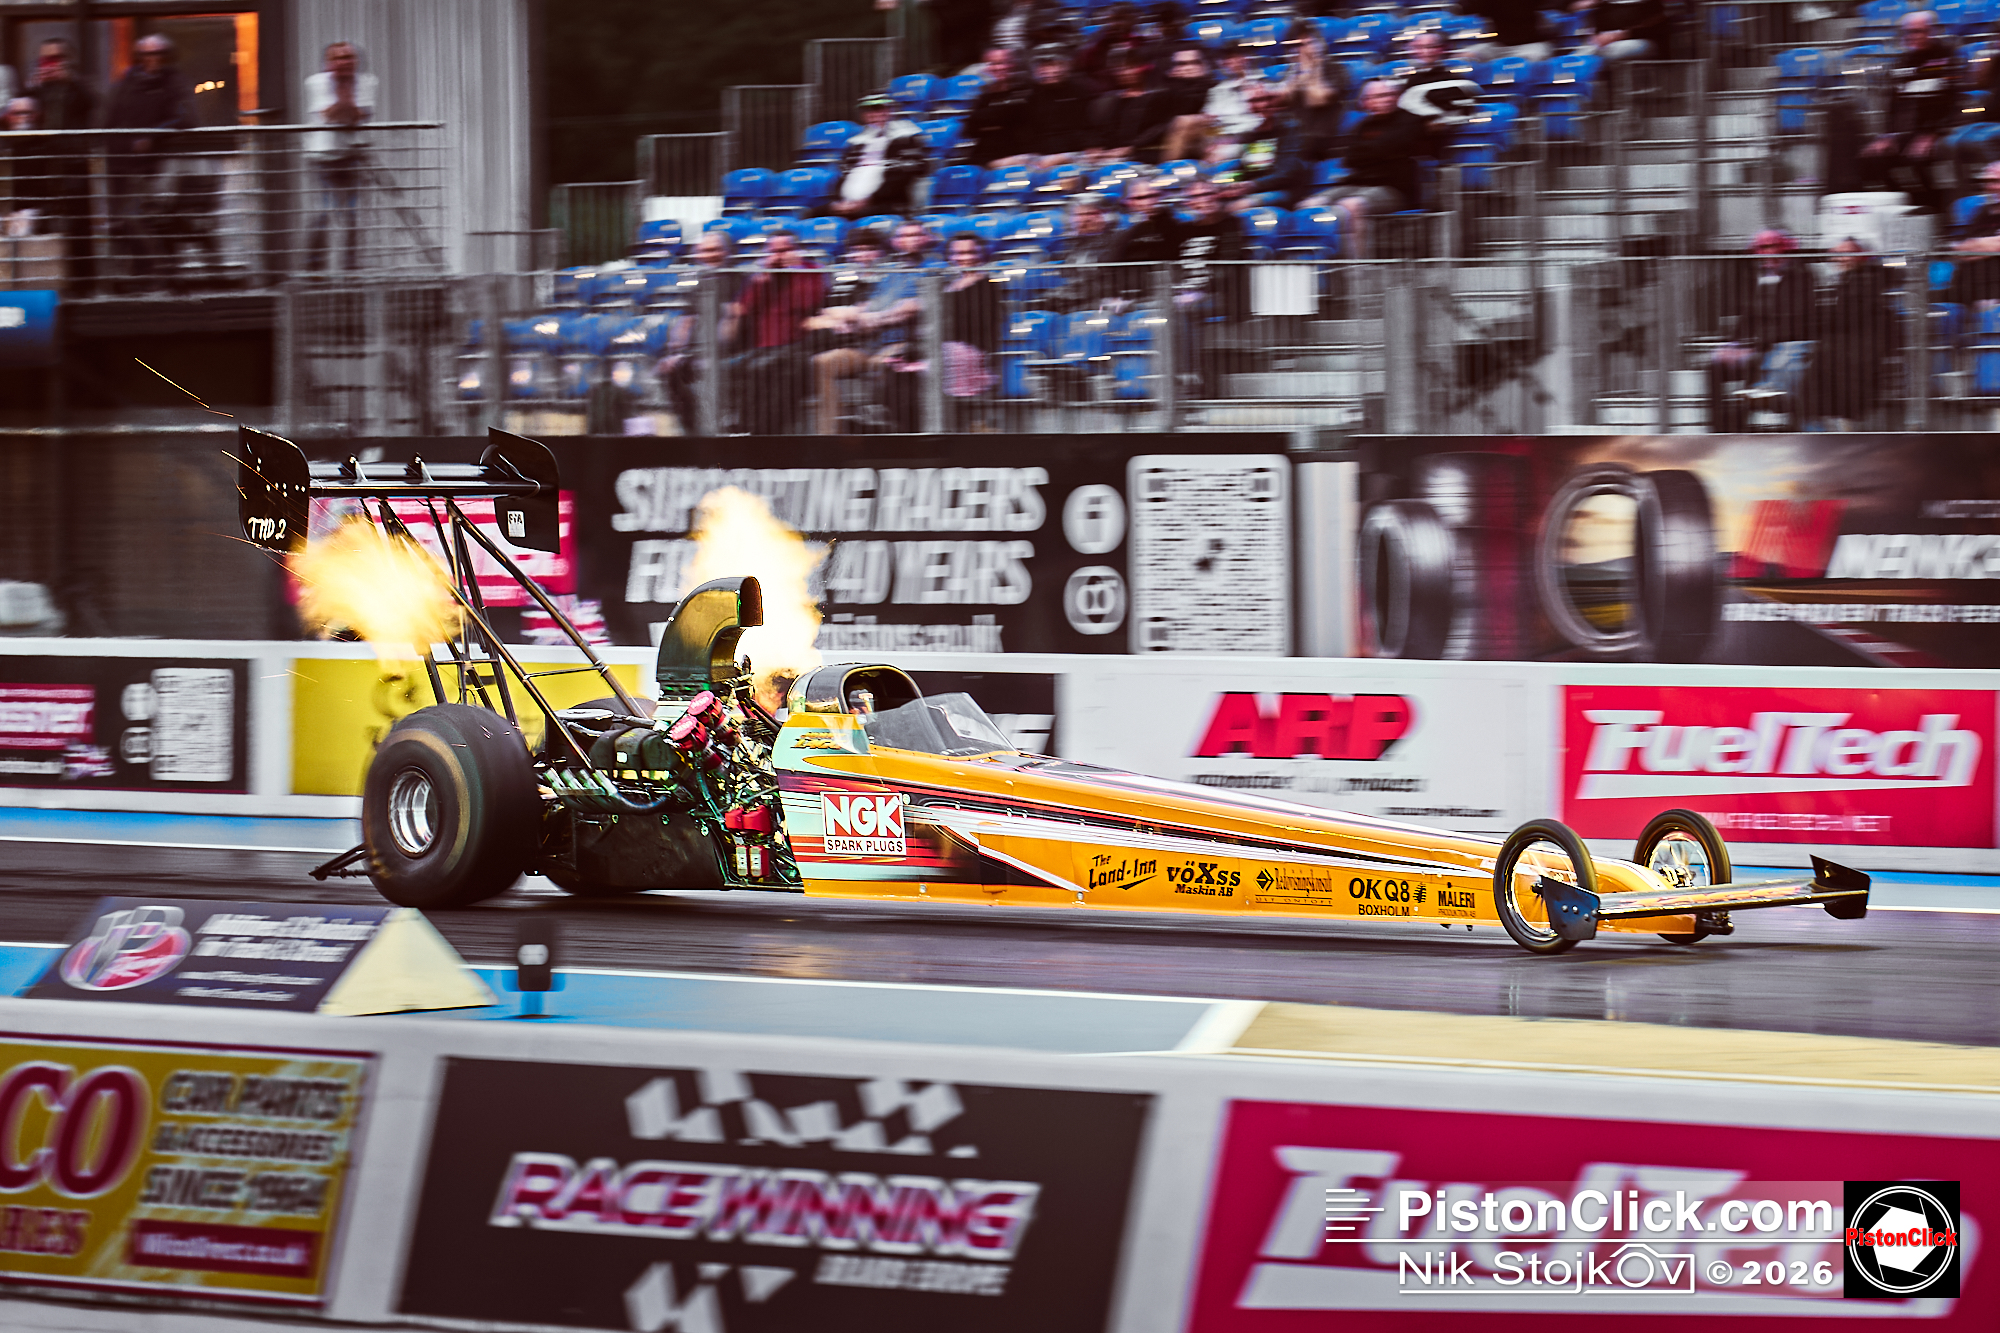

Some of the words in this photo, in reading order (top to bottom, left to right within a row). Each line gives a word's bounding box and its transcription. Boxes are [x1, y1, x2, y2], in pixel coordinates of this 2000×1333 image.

[876, 467, 1049, 532] RACERS
[892, 539, 1035, 605] YEARS
[1190, 690, 1418, 761] ARP
[1577, 709, 1984, 786] FuelTech
[824, 795, 903, 838] NGK
[827, 839, 863, 852] SPARK
[866, 840, 903, 853] PLUGS
[1091, 853, 1112, 868] The
[1174, 883, 1216, 896] Maskin
[1217, 886, 1234, 897] AB
[1358, 903, 1410, 917] BOXHOLM
